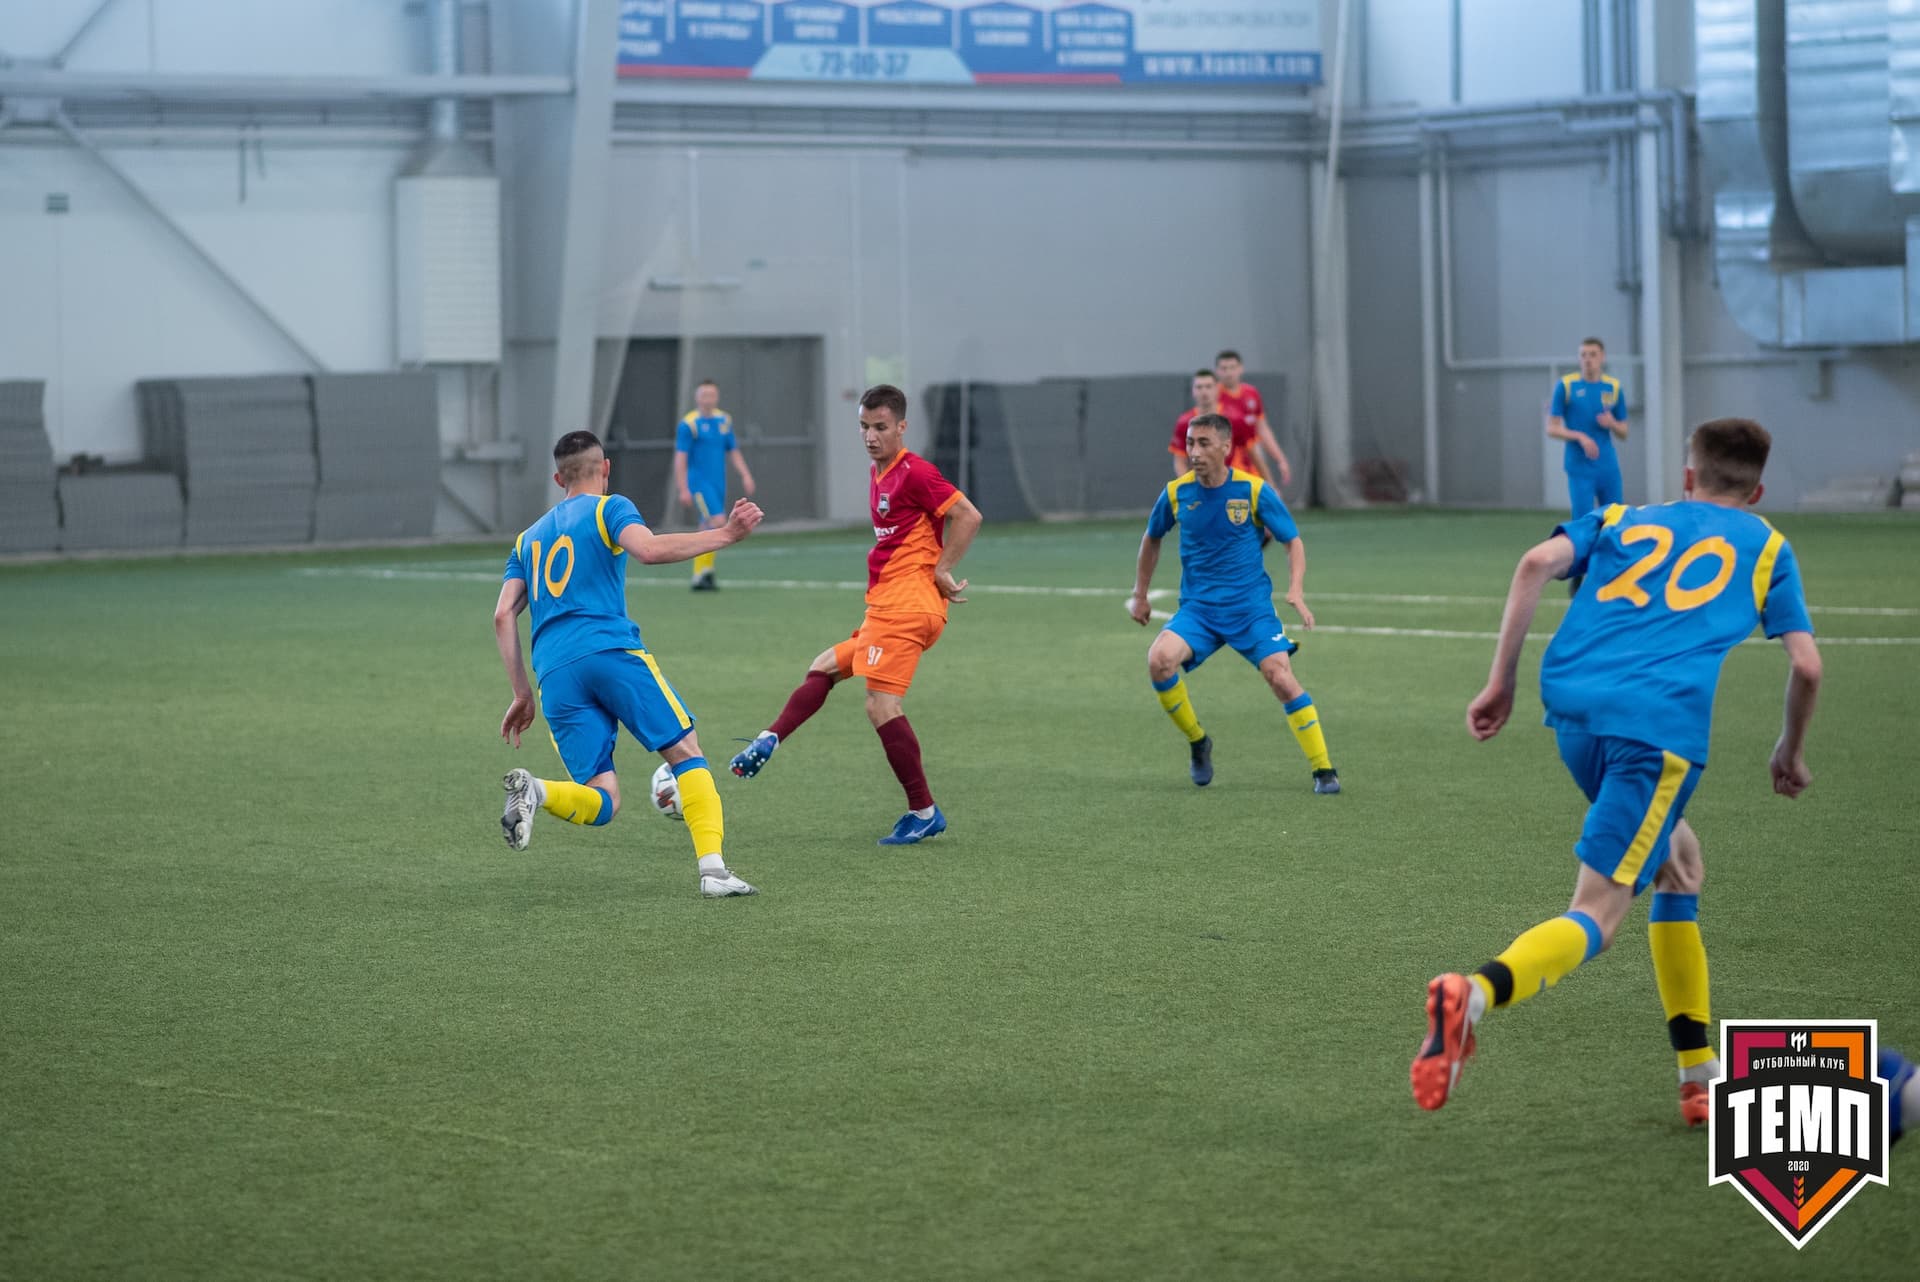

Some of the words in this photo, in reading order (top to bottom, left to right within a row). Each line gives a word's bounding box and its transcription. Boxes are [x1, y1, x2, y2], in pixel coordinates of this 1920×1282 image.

[531, 534, 575, 602] 10
[1596, 523, 1737, 612] 20
[867, 645, 883, 666] 97
